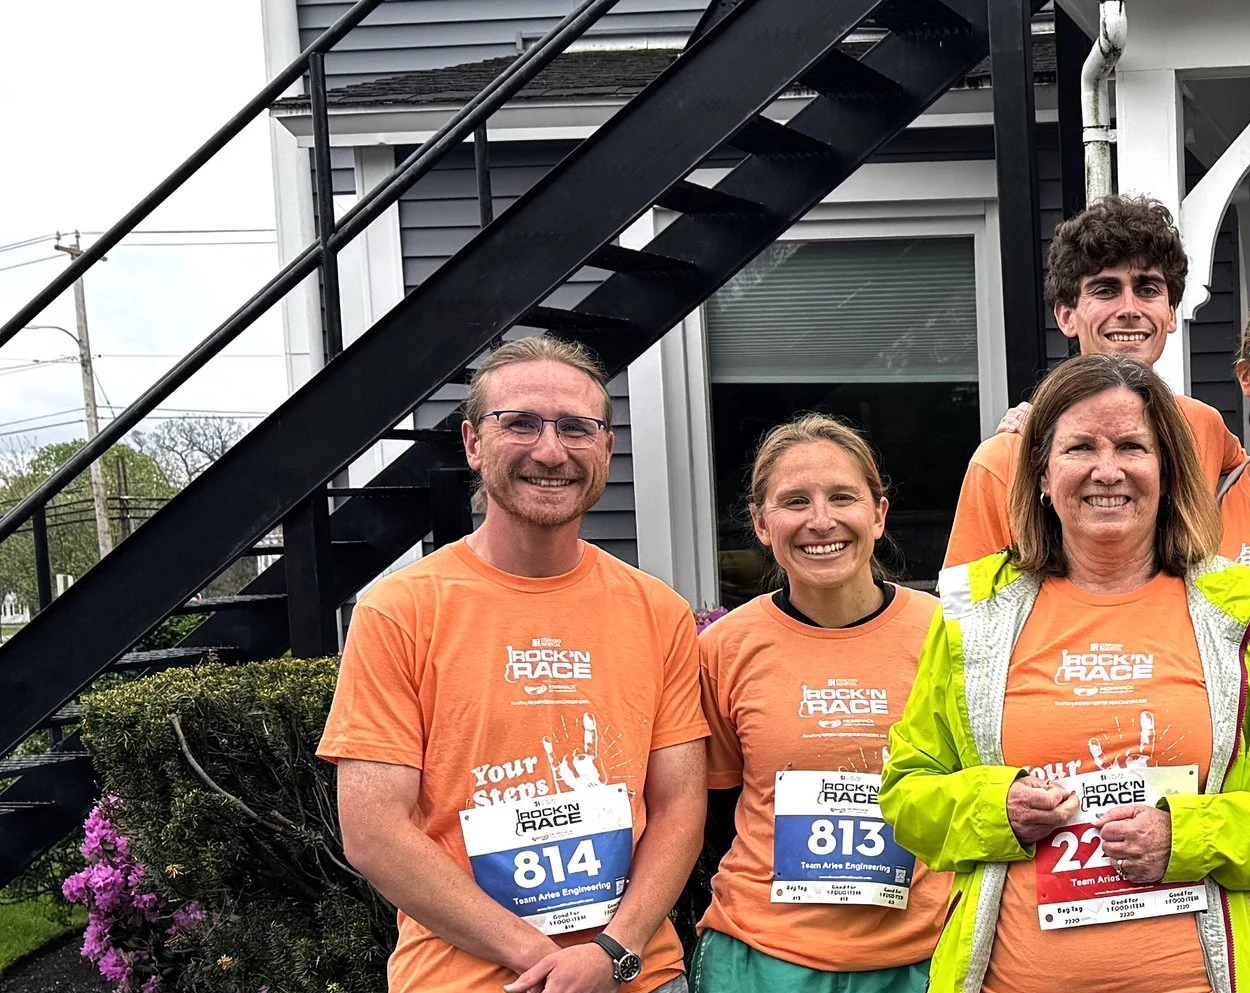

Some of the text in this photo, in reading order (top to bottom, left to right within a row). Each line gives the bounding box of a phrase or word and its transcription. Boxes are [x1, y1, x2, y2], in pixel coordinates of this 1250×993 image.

[512, 650, 591, 662] ROCK'N
[1066, 654, 1153, 666] ROCK'N
[513, 661, 592, 679] RACE
[1064, 664, 1153, 682] RACE
[807, 688, 887, 700] ROCK'N
[808, 700, 889, 715] RACE
[471, 756, 538, 786] Your
[1024, 760, 1082, 780] our
[824, 783, 880, 793] ROCK'N
[1085, 780, 1145, 795] ROCK'N
[824, 792, 879, 805] RACE
[1086, 790, 1146, 808] RACE
[520, 803, 580, 820] ROCK'N
[521, 811, 582, 833] RACE
[807, 819, 886, 857] 813
[1051, 828, 1111, 873] 22
[513, 839, 602, 889] 814
[801, 861, 822, 869] Team
[845, 862, 891, 874] Engineering
[1071, 878, 1095, 887] Team
[513, 896, 537, 905] Team
[538, 891, 561, 902] Aries
[562, 881, 612, 896] Engineering
